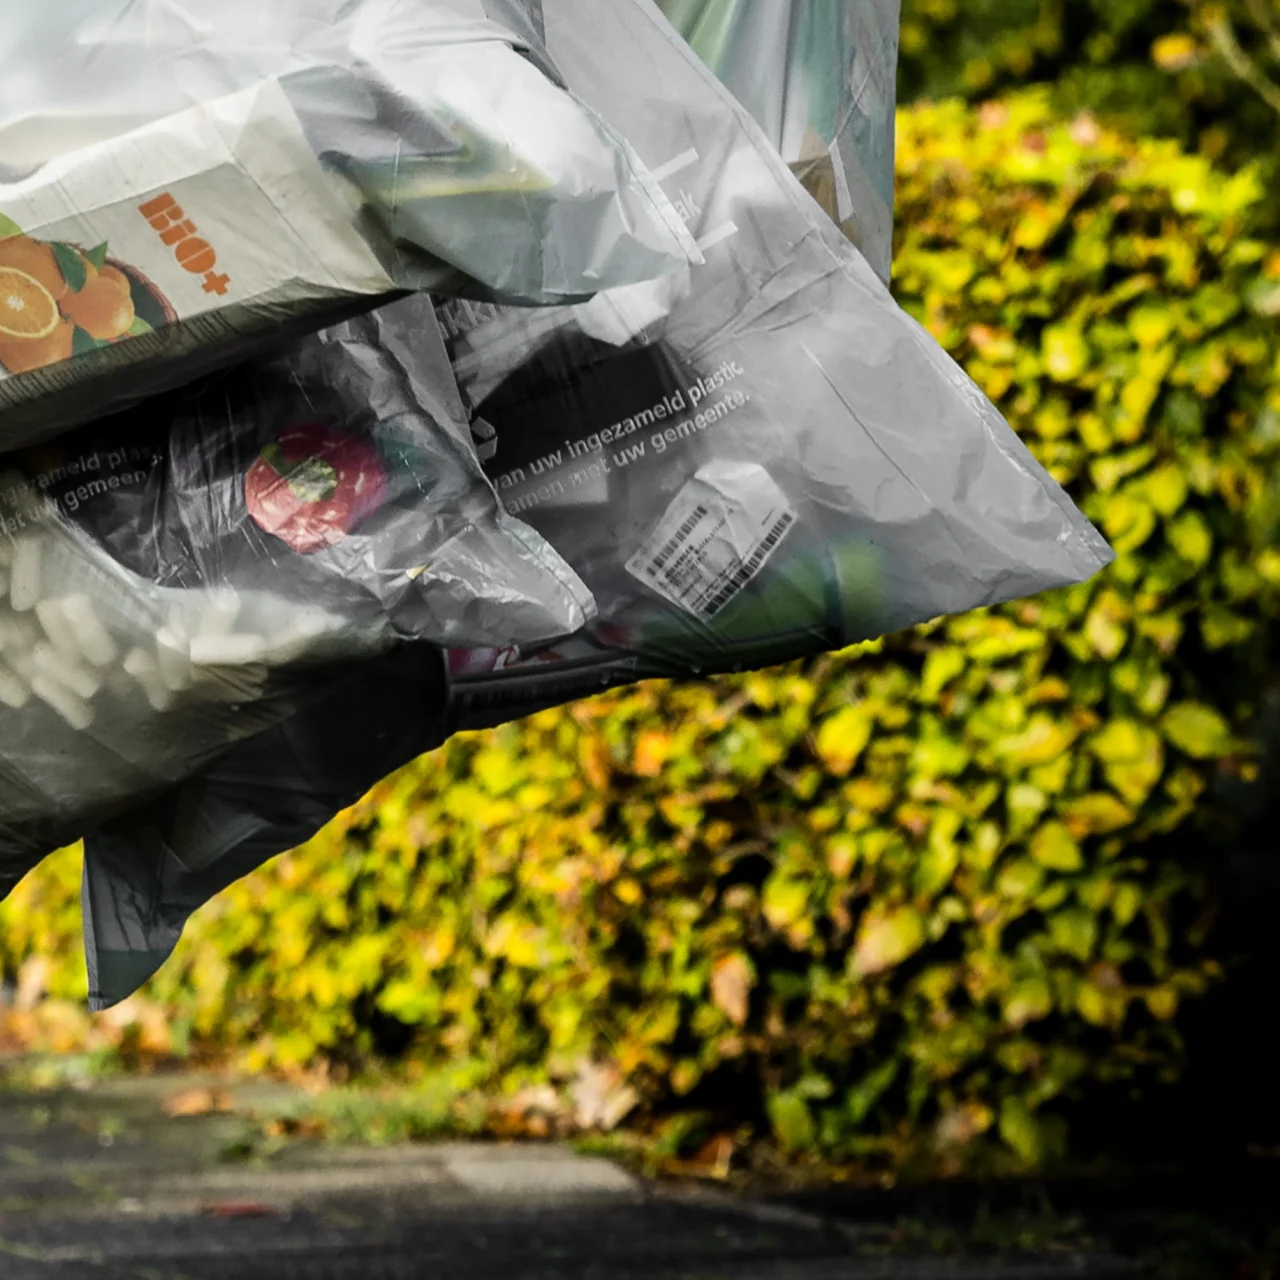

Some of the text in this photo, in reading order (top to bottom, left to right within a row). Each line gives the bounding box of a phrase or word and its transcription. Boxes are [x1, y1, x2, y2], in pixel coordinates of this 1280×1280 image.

[529, 450, 565, 477] uw
[564, 390, 686, 458] ingezameld
[612, 440, 648, 468] uw
